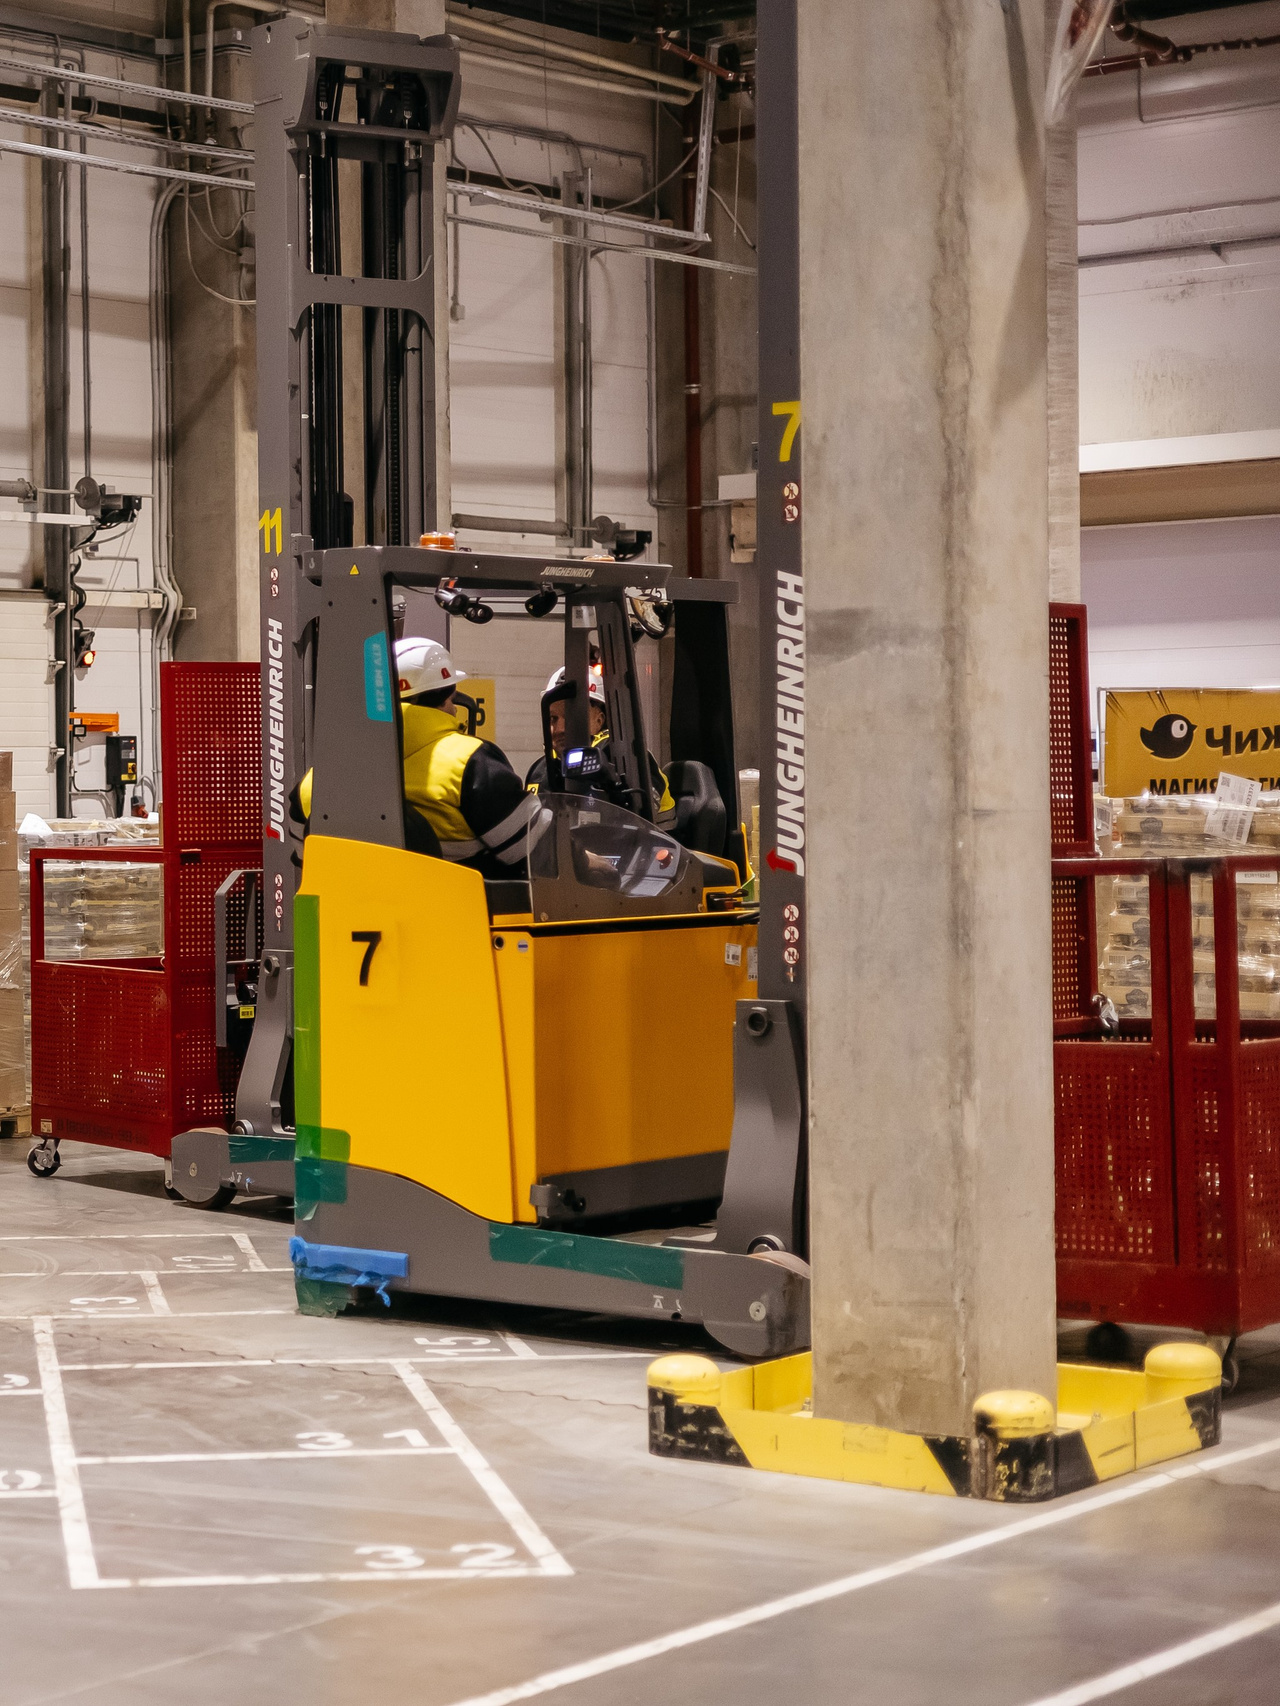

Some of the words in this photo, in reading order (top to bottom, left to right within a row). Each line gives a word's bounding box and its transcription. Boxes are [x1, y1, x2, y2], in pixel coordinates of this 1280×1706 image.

[772, 401, 801, 462] 7
[259, 508, 282, 557] 11
[541, 566, 595, 578] JUNGHEINRICH
[268, 618, 285, 842] JUNGHEINRICH
[777, 570, 805, 877] JUNGHEINRICH
[352, 931, 382, 986] 7
[415, 1336, 500, 1355] 15
[295, 1429, 431, 1453] 31
[354, 1541, 523, 1570] 32
